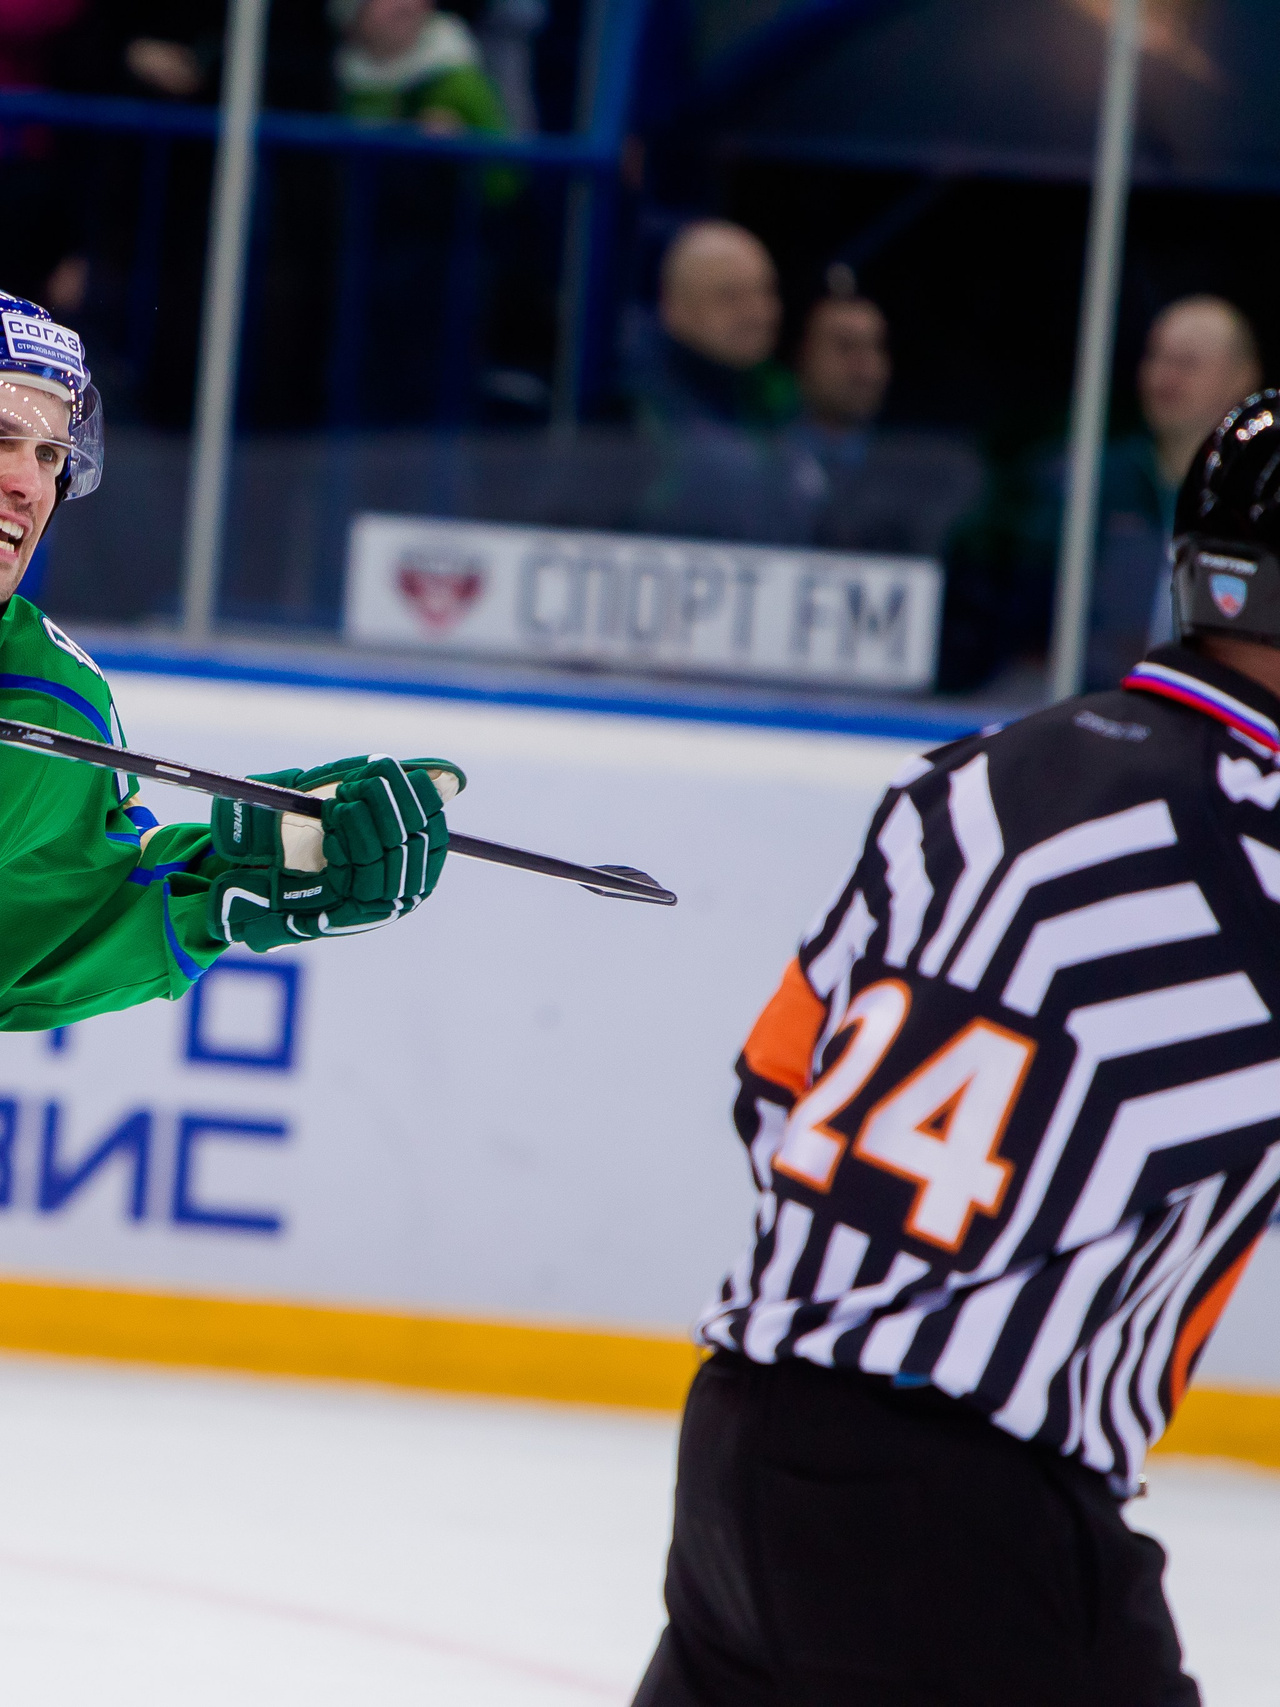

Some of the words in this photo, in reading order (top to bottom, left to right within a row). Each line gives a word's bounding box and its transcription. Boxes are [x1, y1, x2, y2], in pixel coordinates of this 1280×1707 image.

[8, 320, 80, 353] СОГАЗ
[283, 885, 323, 900] BAUER
[770, 976, 1039, 1254] 24
